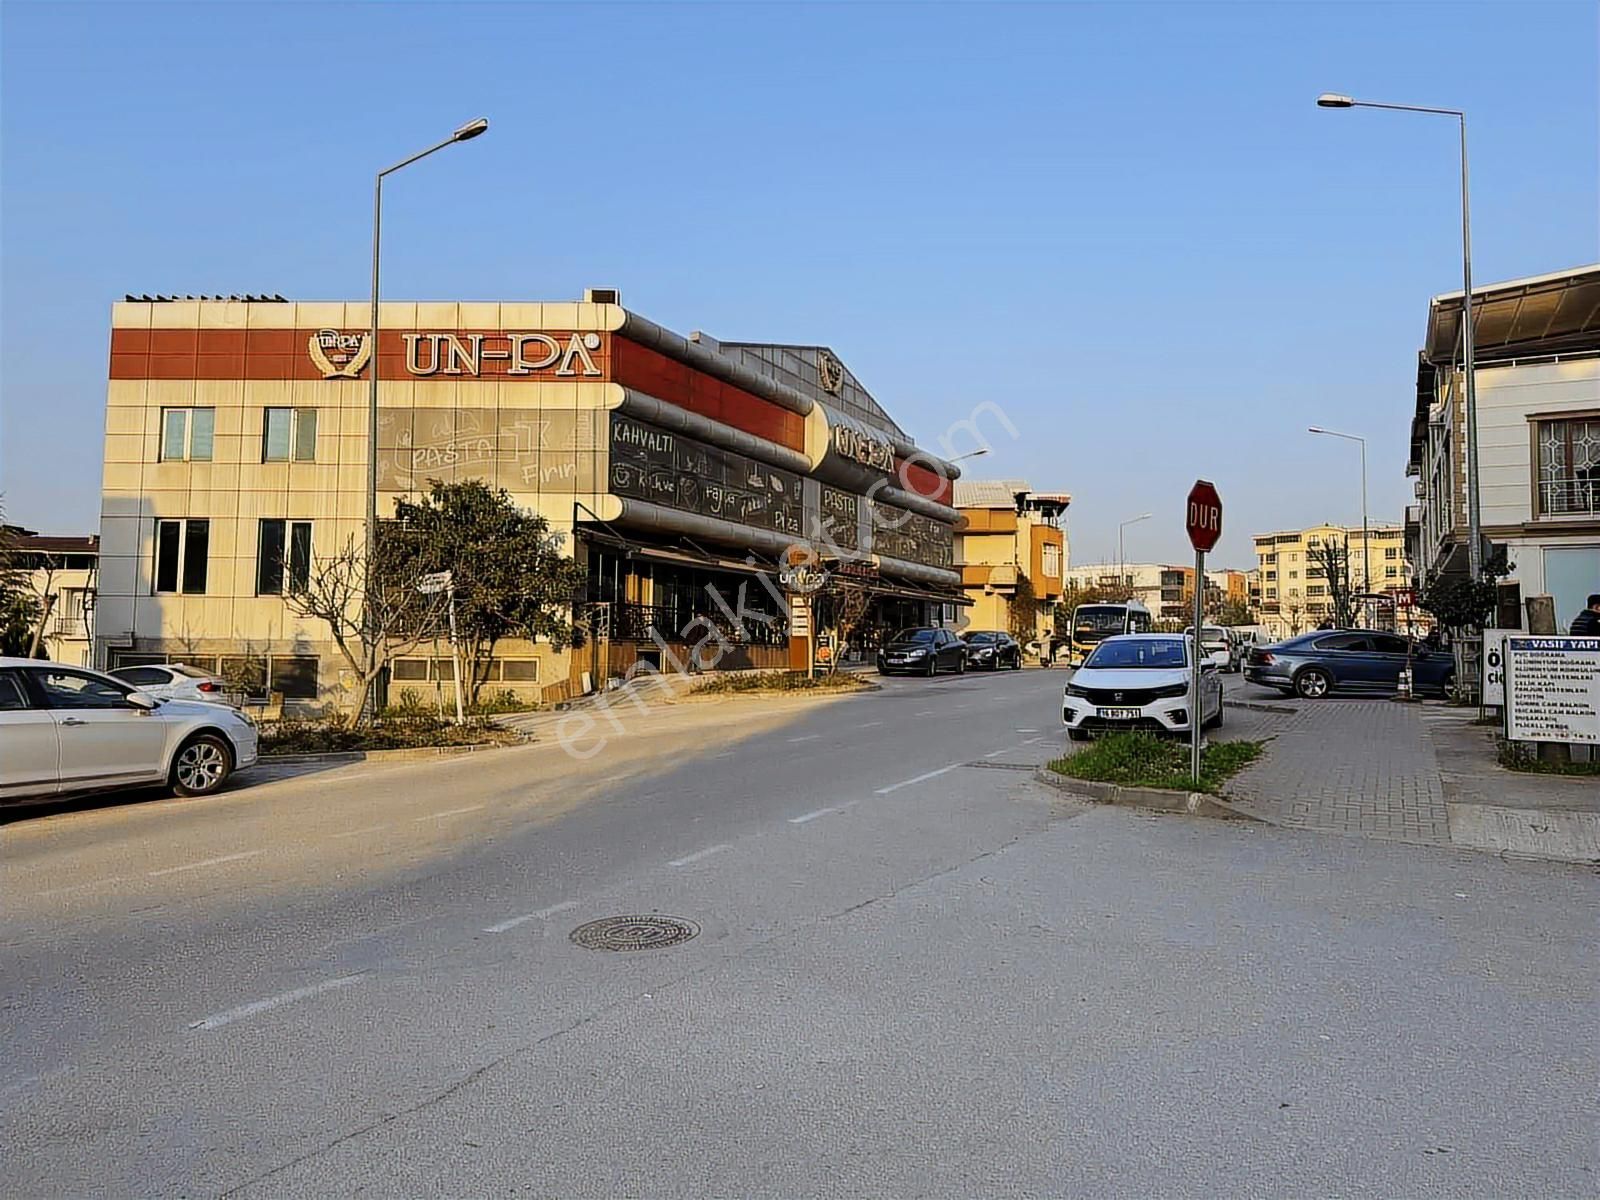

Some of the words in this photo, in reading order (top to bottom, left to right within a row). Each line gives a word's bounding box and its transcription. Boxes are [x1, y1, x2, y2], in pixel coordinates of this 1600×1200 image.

[613, 423, 673, 452] KAHVALTI
[412, 438, 494, 469] PASTA
[823, 490, 856, 515] PASTA
[1190, 501, 1219, 532] DUR
[1570, 640, 1599, 649] YAPI
